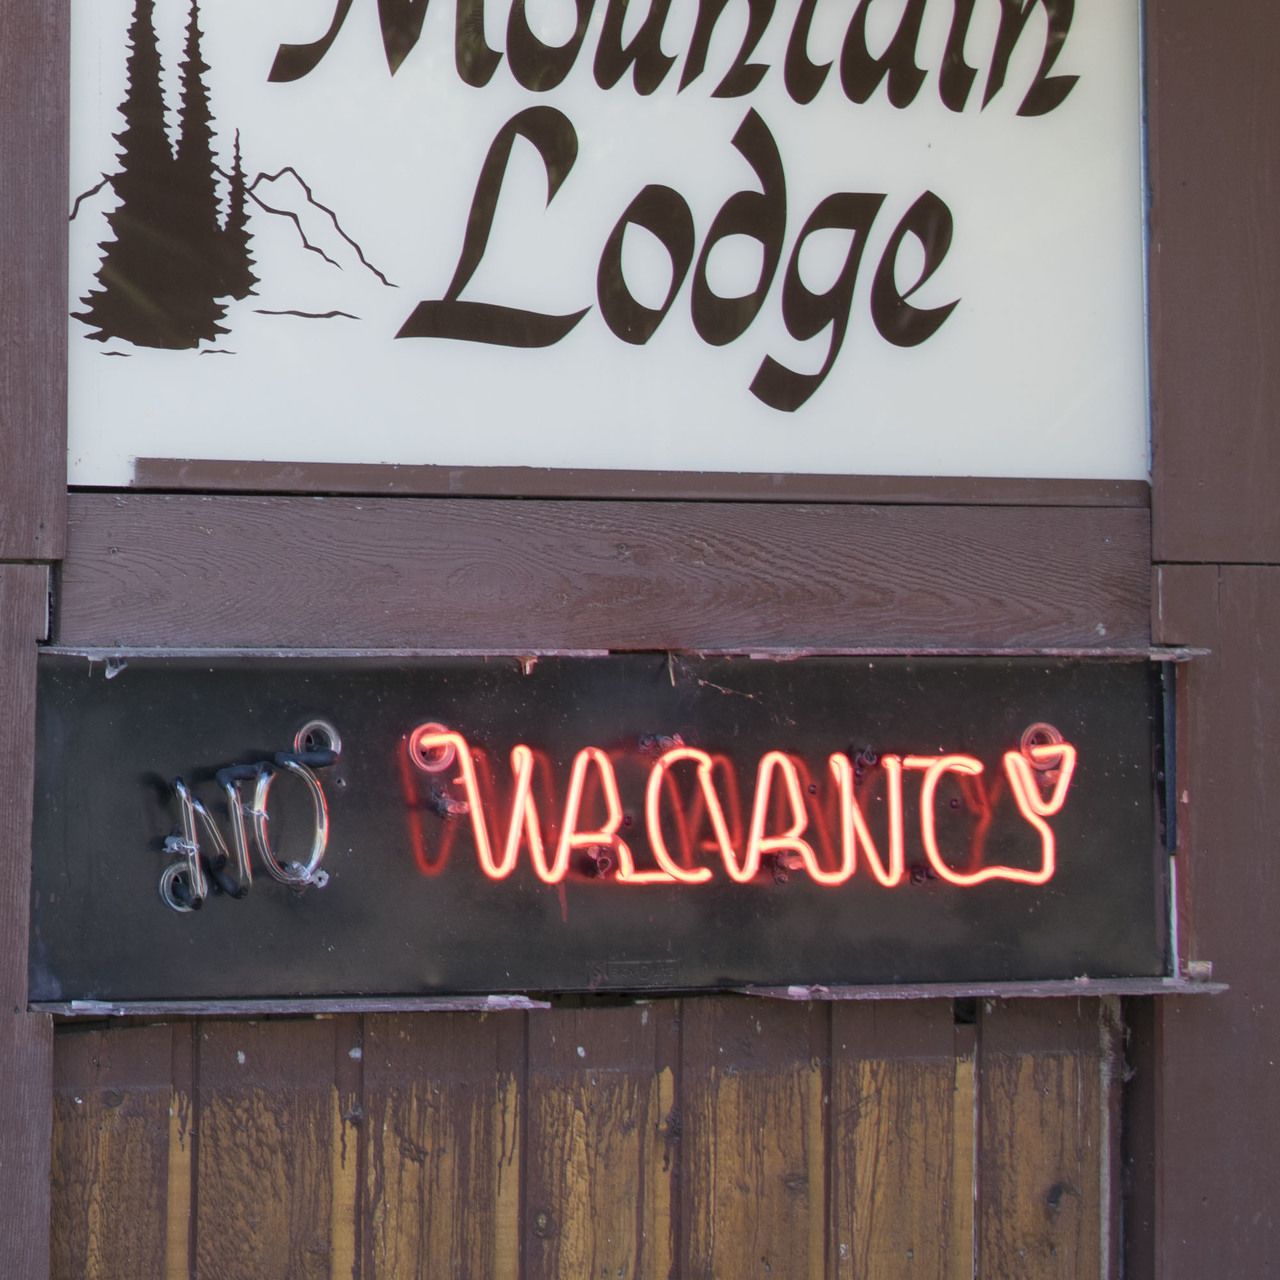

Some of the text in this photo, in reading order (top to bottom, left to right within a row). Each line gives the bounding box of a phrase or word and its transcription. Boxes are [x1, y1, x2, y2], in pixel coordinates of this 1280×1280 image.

[396, 106, 961, 413] Lodge
[162, 724, 1078, 910] NO VACANCY
